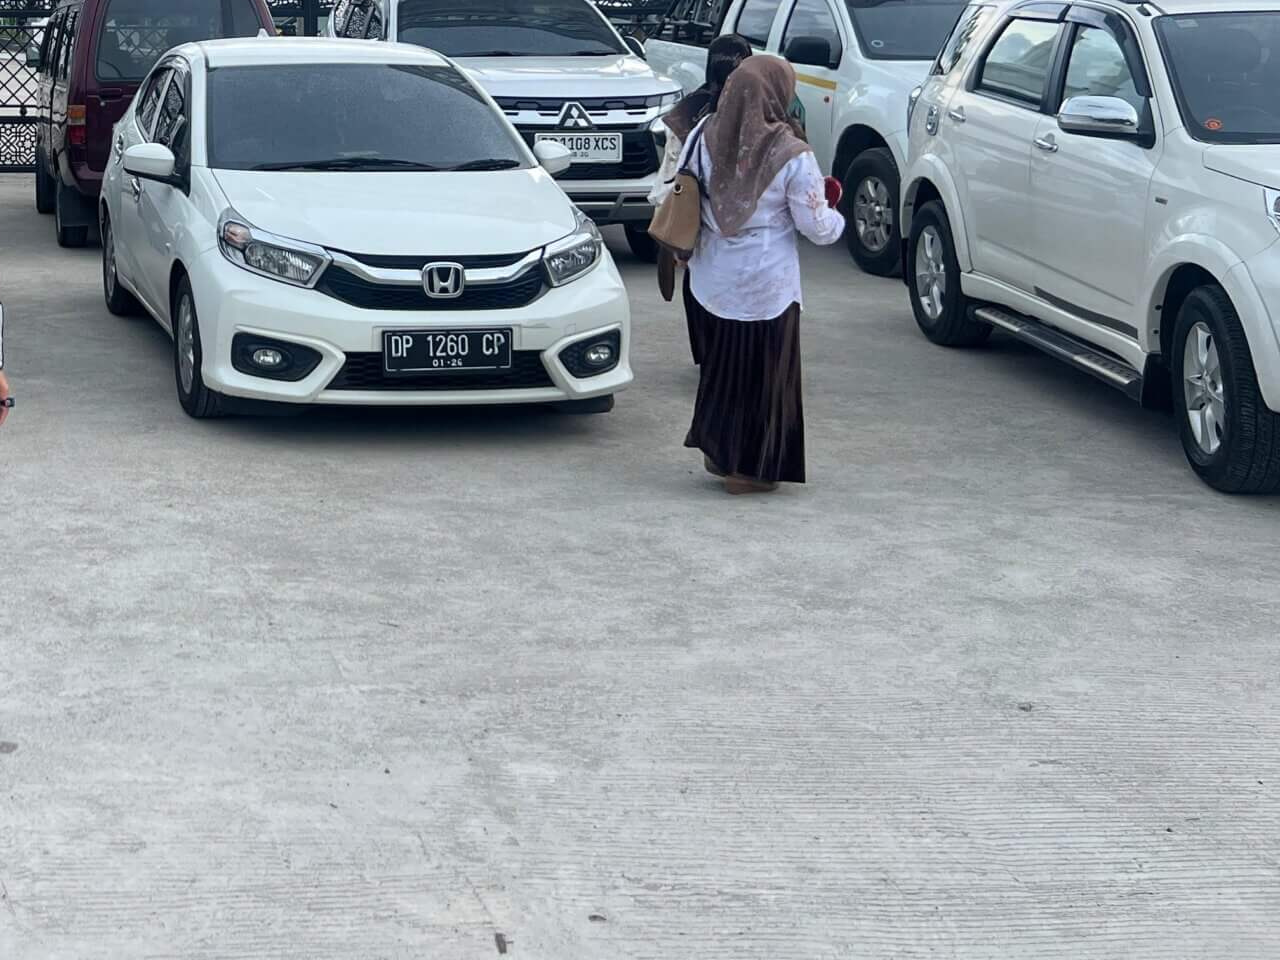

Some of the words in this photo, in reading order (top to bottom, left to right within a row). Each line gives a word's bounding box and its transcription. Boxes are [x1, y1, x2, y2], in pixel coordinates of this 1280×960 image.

[593, 137, 617, 151] XCS
[391, 335, 413, 357] DP
[426, 334, 469, 357] 1260
